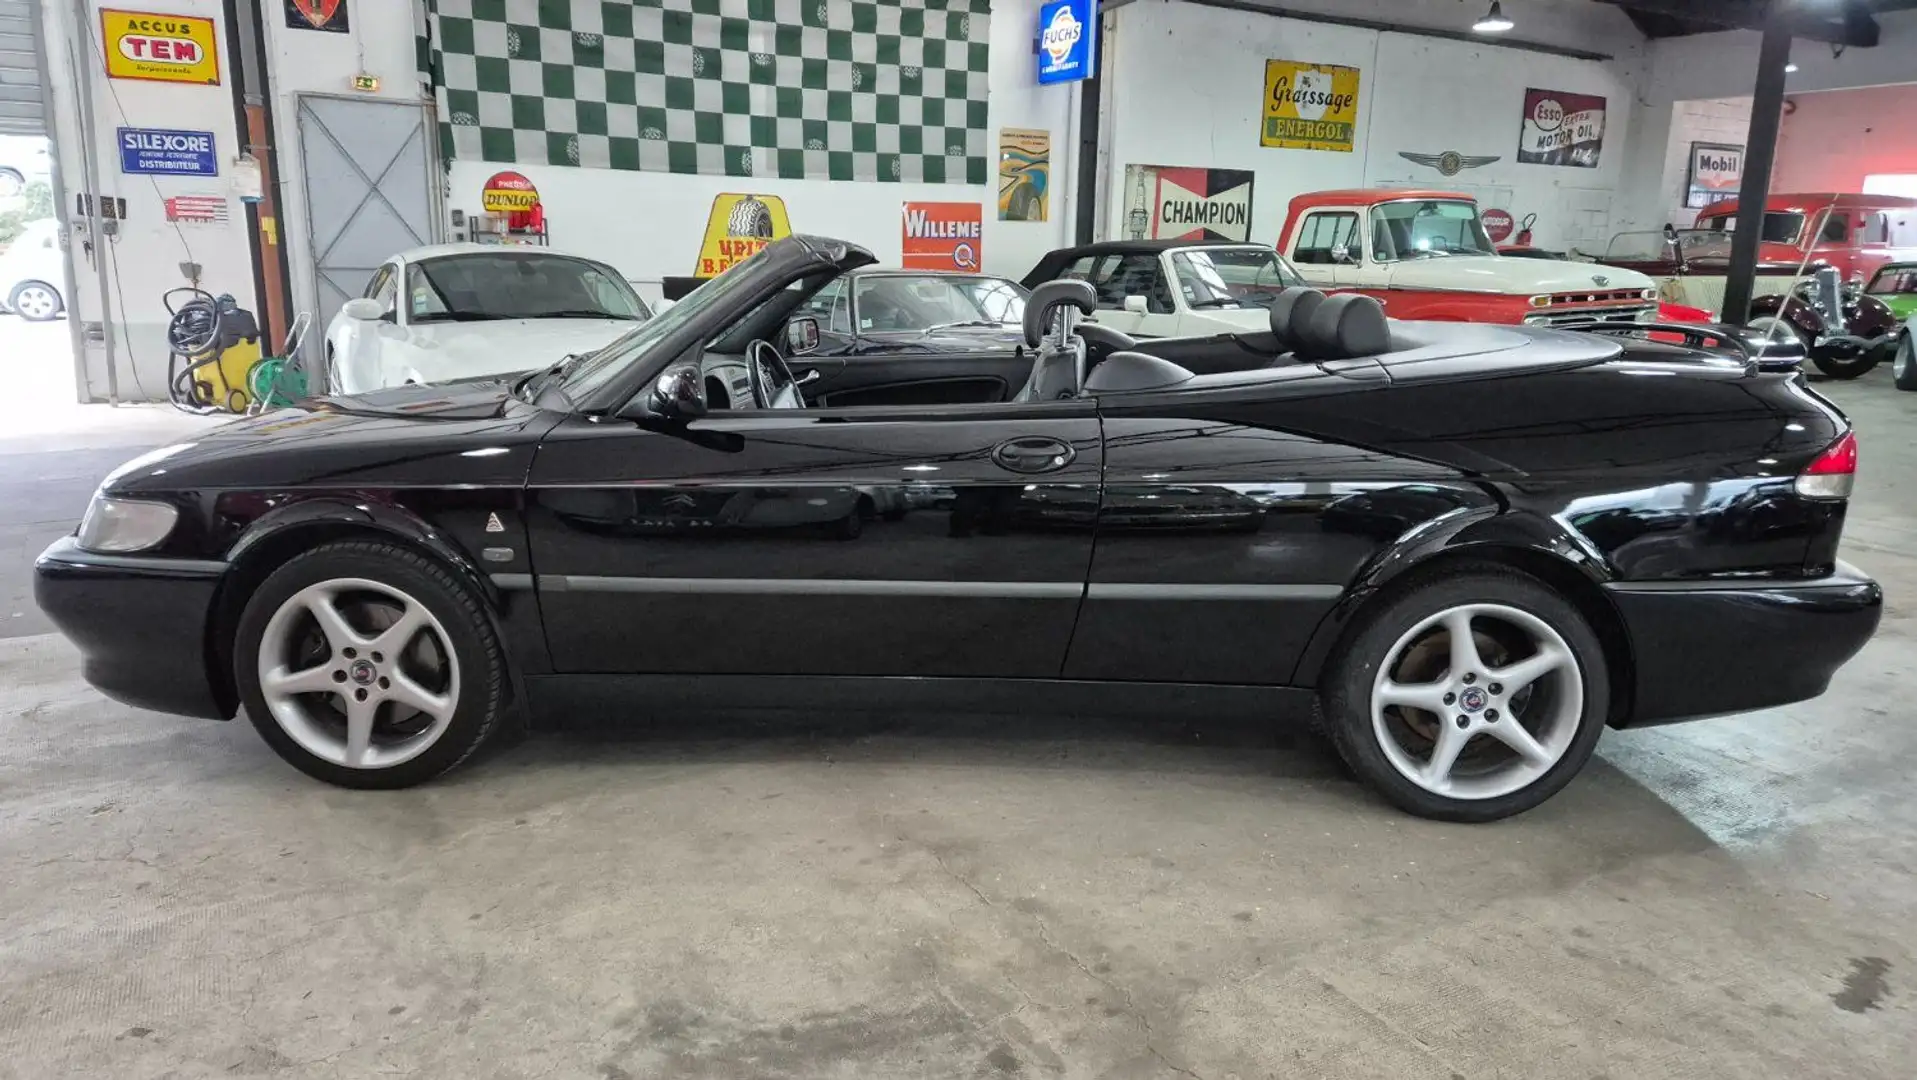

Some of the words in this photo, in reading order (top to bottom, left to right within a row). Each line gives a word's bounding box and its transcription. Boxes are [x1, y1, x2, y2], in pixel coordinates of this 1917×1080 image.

[128, 19, 191, 34] ACCUS
[1044, 25, 1080, 45] FUCHS
[126, 37, 196, 61] TEM
[1271, 76, 1353, 114] Graissage
[1275, 119, 1344, 140] ENERGOL
[1536, 128, 1573, 149] MOTOR
[125, 133, 210, 152] SILEXORE
[139, 159, 201, 171] DISTRIBUTEUR
[1699, 155, 1737, 172] Mobil
[486, 194, 538, 207] DUNLOP
[1162, 200, 1245, 225] CHAMPION
[902, 208, 980, 238] WILLEME
